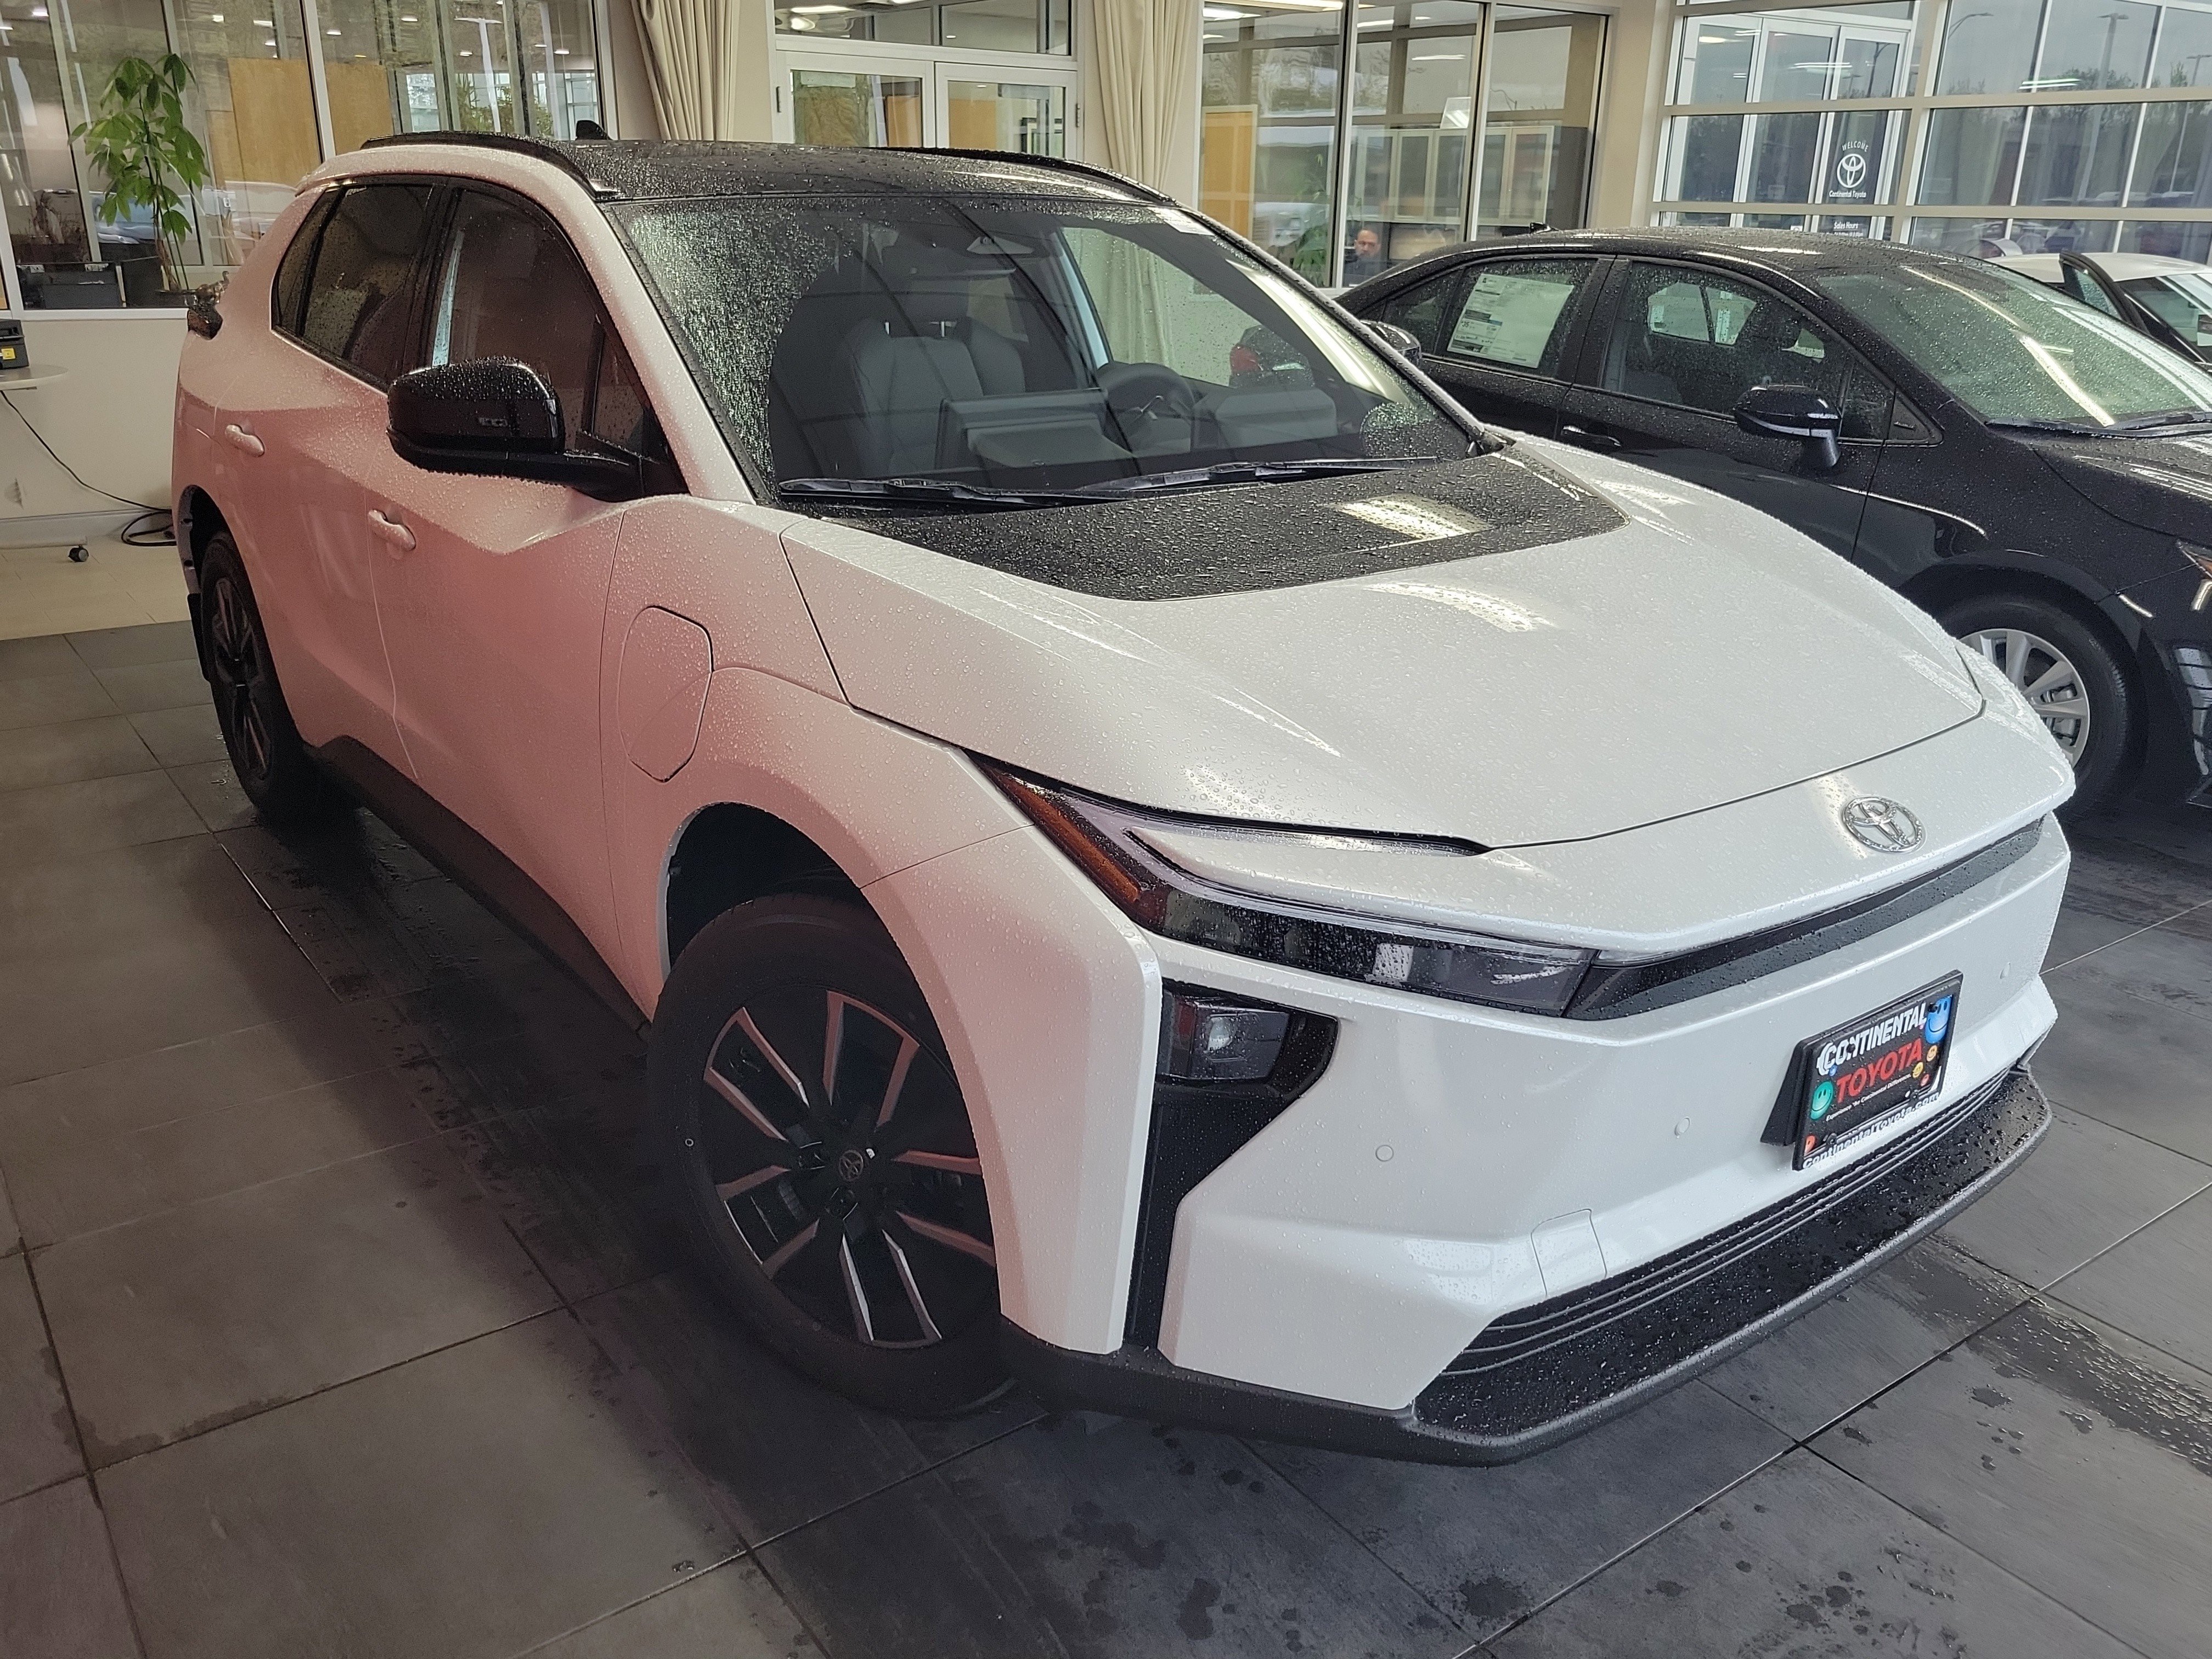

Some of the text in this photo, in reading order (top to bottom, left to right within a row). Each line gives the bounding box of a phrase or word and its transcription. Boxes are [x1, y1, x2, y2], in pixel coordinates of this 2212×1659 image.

[1842, 141, 1869, 152] WELCOME
[1852, 191, 1866, 199] Toyota
[1833, 221, 1845, 229] Sales
[1816, 1002, 1927, 1076] CONTINENTAL
[1836, 1038, 1922, 1104] TOYOTA
